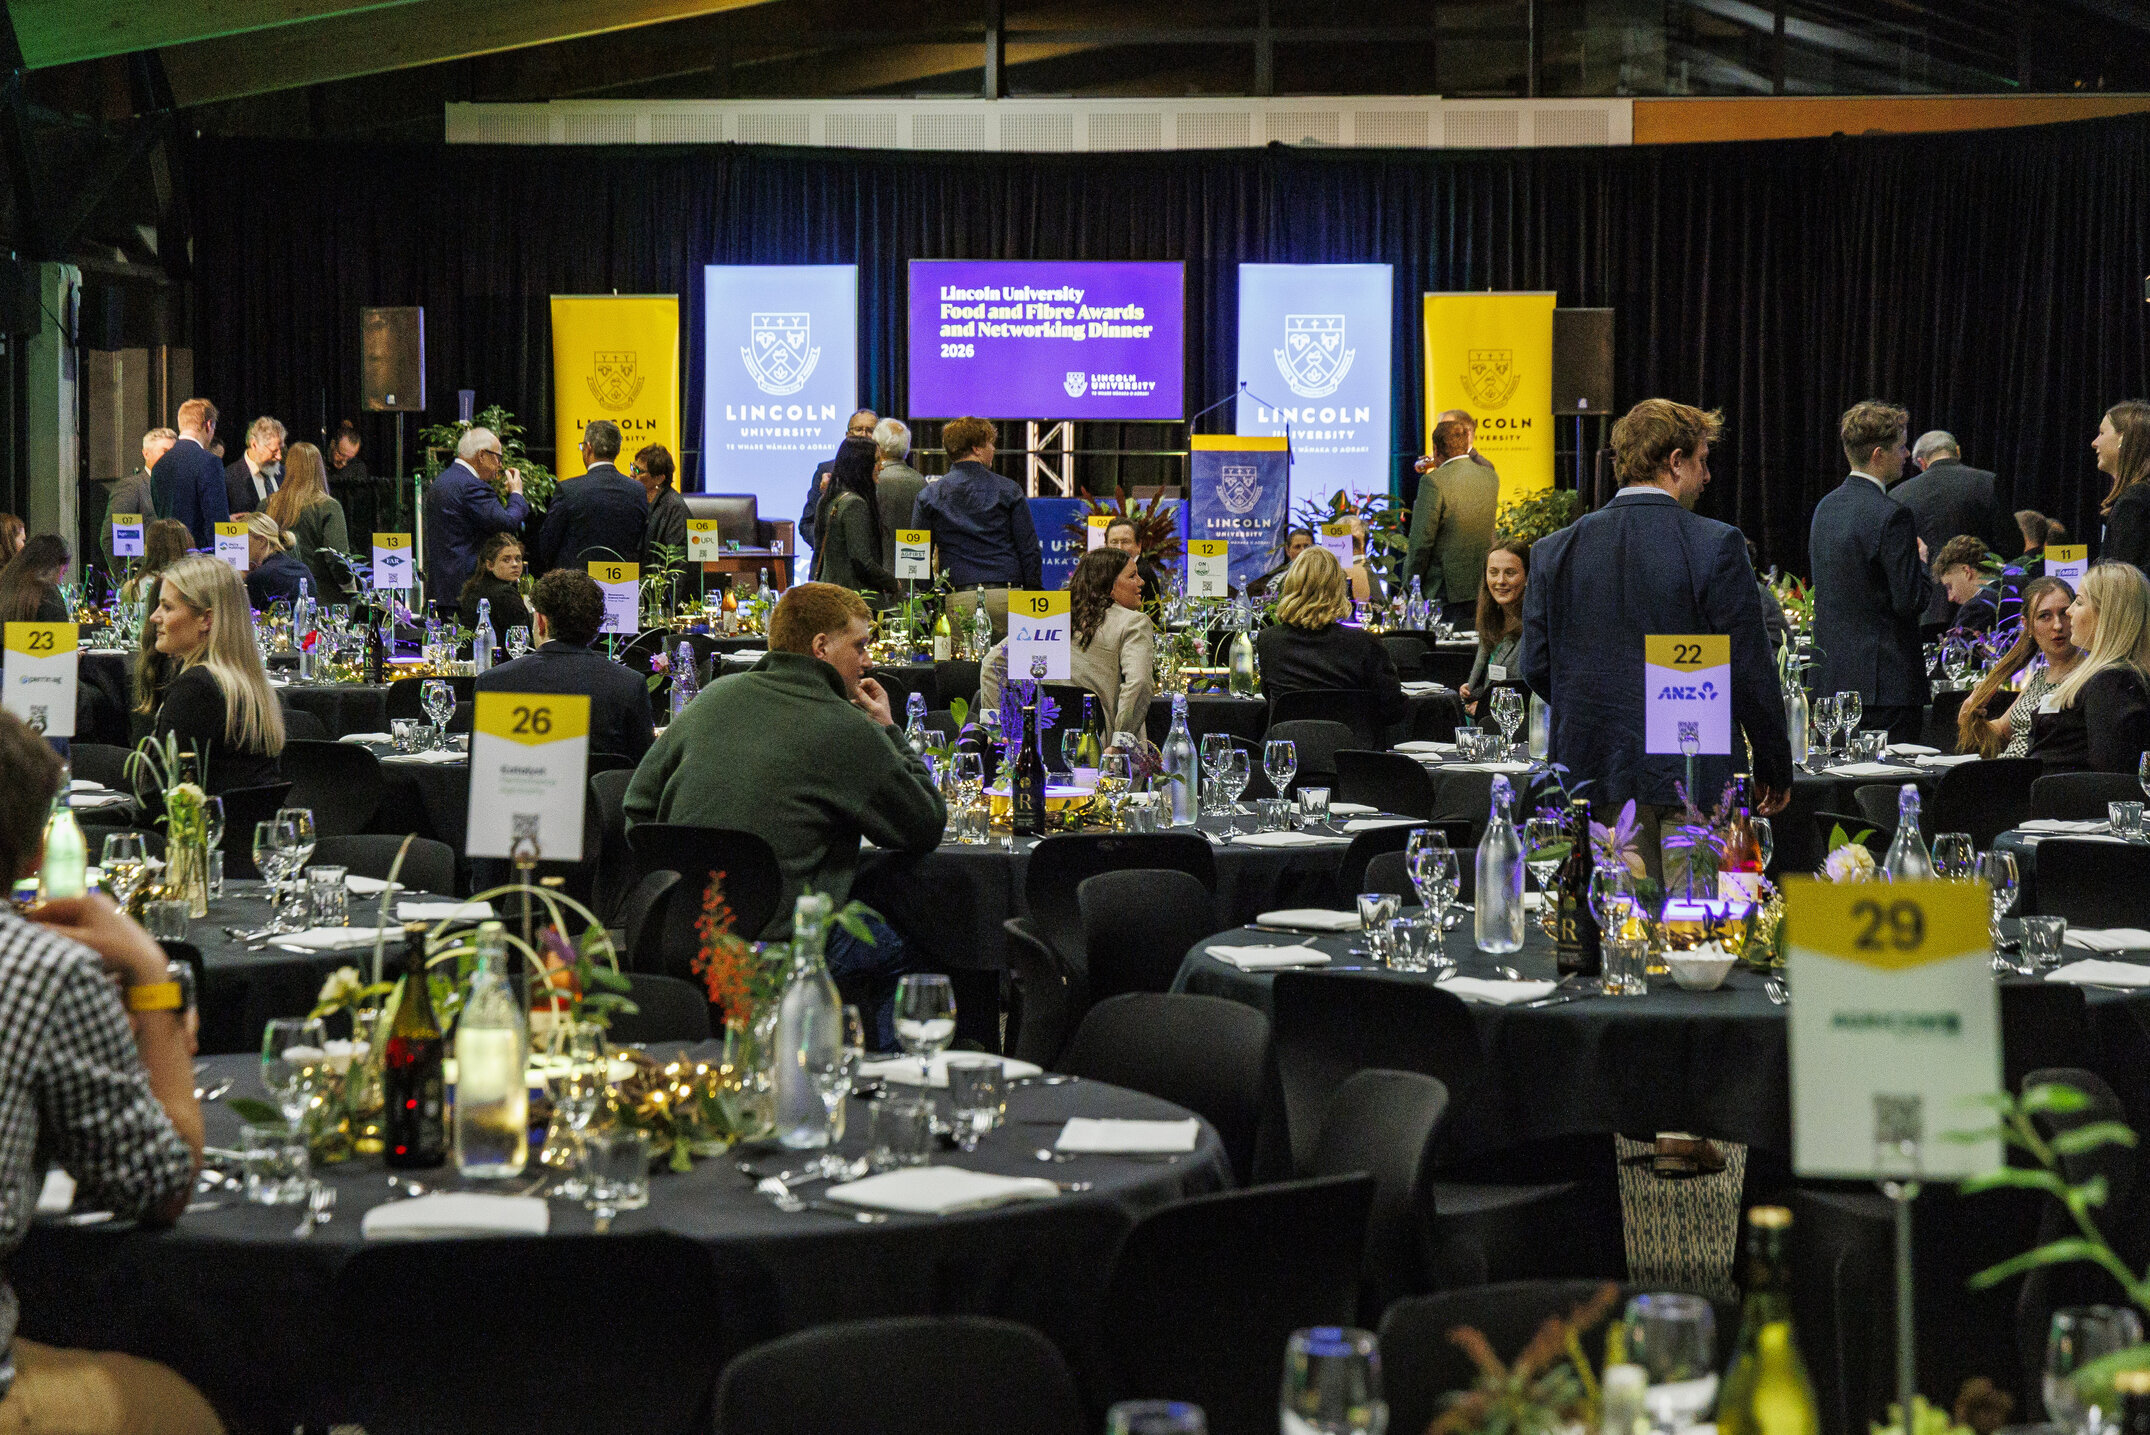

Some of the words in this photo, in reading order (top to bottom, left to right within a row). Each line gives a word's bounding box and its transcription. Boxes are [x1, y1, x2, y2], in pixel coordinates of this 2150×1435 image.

[940, 285, 1000, 301] Lincoln
[1002, 285, 1085, 304] University
[940, 303, 986, 320] Food
[987, 303, 1023, 320] and
[1025, 302, 1075, 320] Fibre
[1076, 303, 1145, 320] Awards
[939, 321, 975, 337] and
[977, 321, 1086, 341] Networking
[1088, 321, 1153, 338] Dinner
[940, 343, 975, 358] 2026
[1091, 374, 1136, 382] LINCOLN
[1091, 381, 1156, 390] UNIVERSITY
[726, 404, 836, 421] LINCOLN
[1257, 406, 1370, 424] LINCOLN
[577, 419, 656, 429] LOLN
[741, 427, 822, 437] UNIVERSITY
[695, 522, 708, 530] 06
[1207, 518, 1271, 528] LINCOLN
[226, 526, 237, 535] 10
[1330, 527, 1343, 535] 05
[386, 537, 398, 547] 13
[906, 533, 920, 542] 09
[1202, 544, 1214, 554] 12
[2061, 549, 2071, 559] 11
[605, 567, 622, 579] 16
[1030, 597, 1049, 612] 19
[29, 631, 54, 650] 23
[1033, 629, 1063, 641] LIC
[1673, 644, 1702, 664] 22
[1657, 687, 1697, 700] ANZ
[512, 706, 553, 735] 26
[1020, 793, 1032, 810] R
[1562, 918, 1578, 941] R
[1851, 899, 1927, 952] 29
